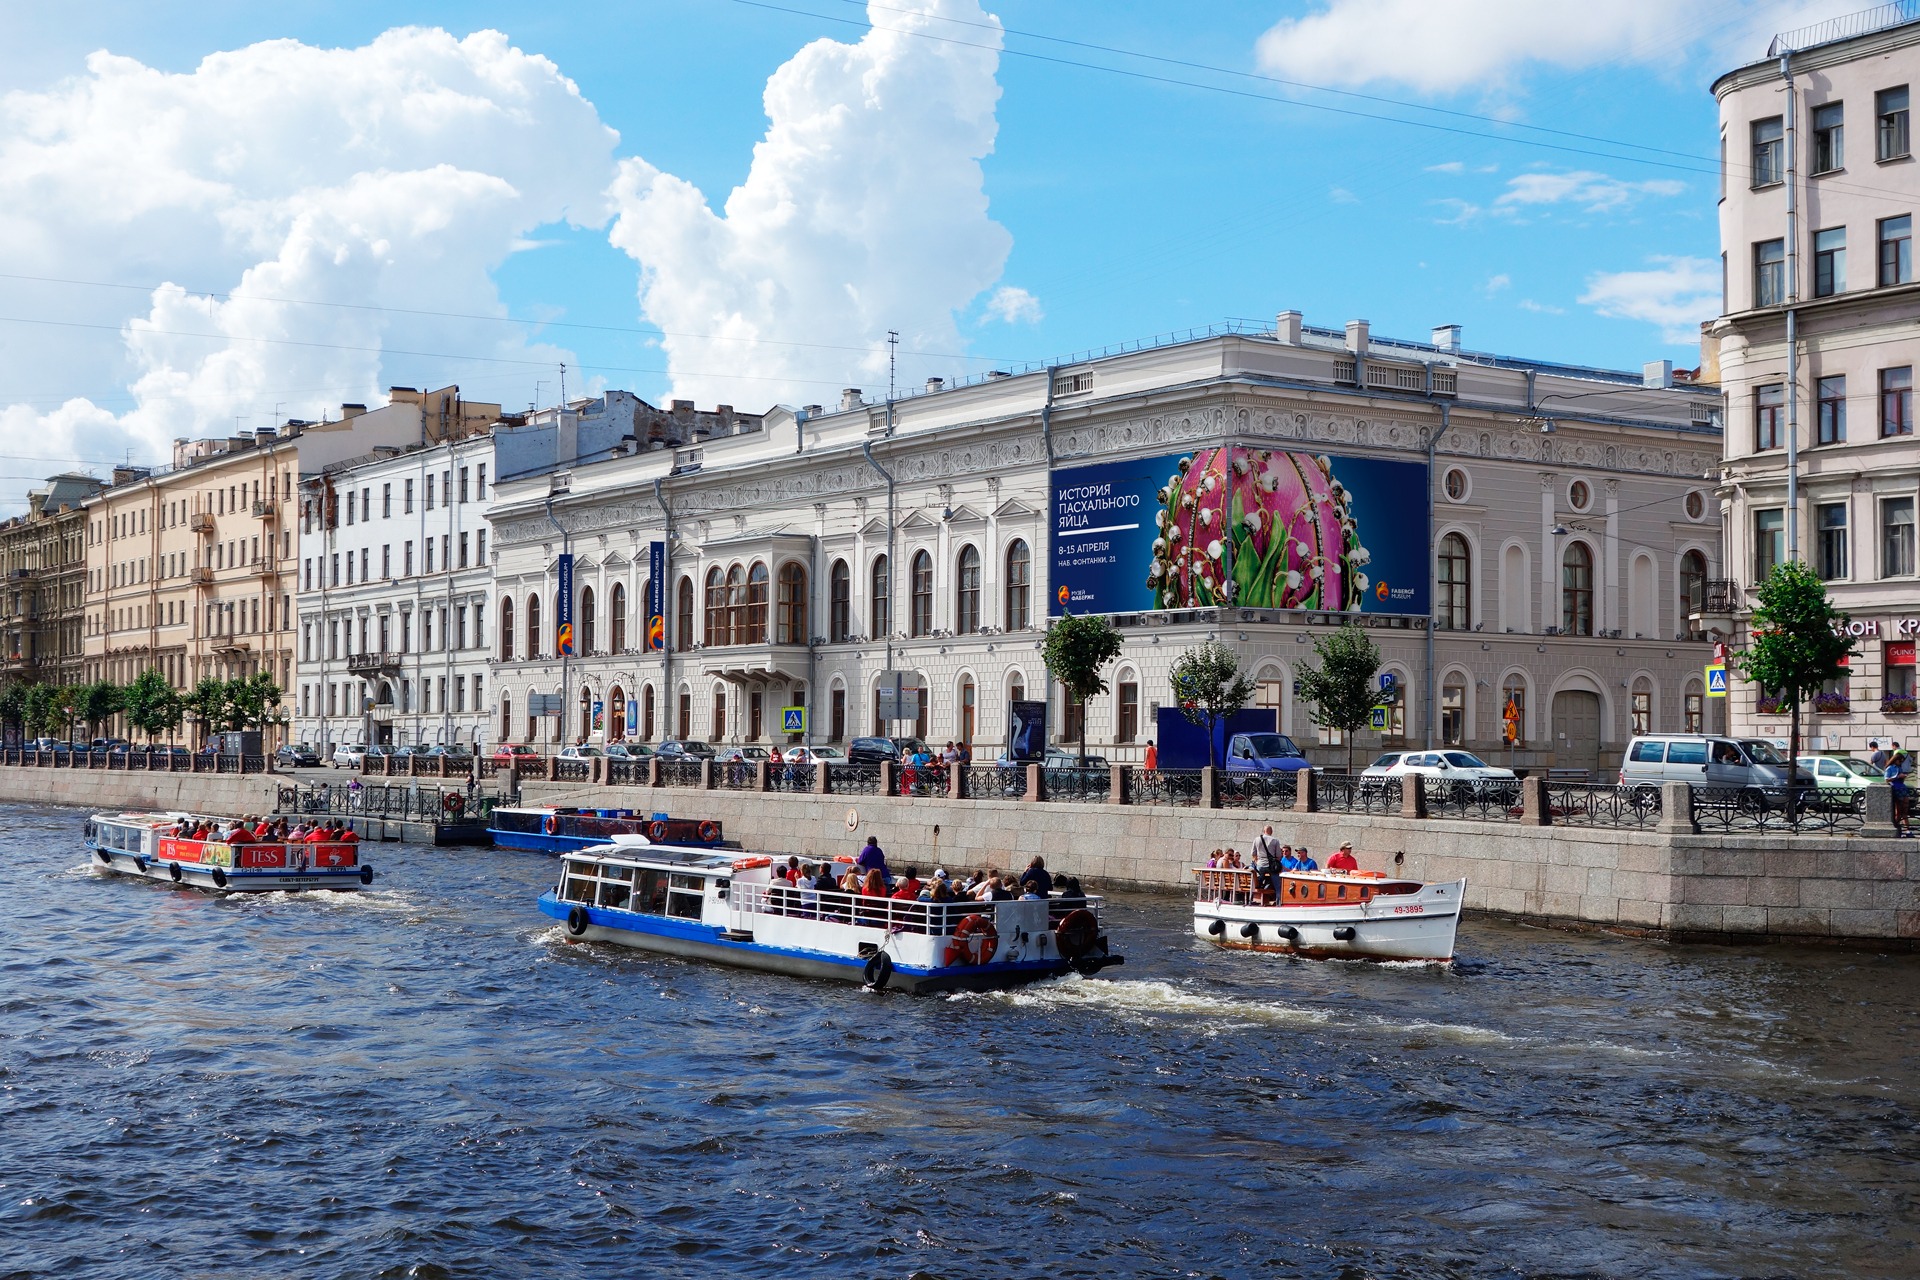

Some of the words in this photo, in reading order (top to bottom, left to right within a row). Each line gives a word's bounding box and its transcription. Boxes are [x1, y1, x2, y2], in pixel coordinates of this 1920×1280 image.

[1059, 484, 1111, 500] ИСТОРИЯ
[1059, 495, 1140, 514] ПАСХАЛЬНОГО
[1058, 514, 1089, 528] ЯЙЦА
[1058, 545, 1075, 555] 8-15
[1077, 541, 1110, 553] АПРЕЛЯ
[1058, 559, 1071, 567] НАБ.
[1072, 556, 1108, 566] ФОНТАНКИ,
[1109, 555, 1116, 563] 21
[1897, 619, 1920, 634] КР
[250, 849, 278, 863] TESS
[1394, 905, 1423, 913] 49-3895
